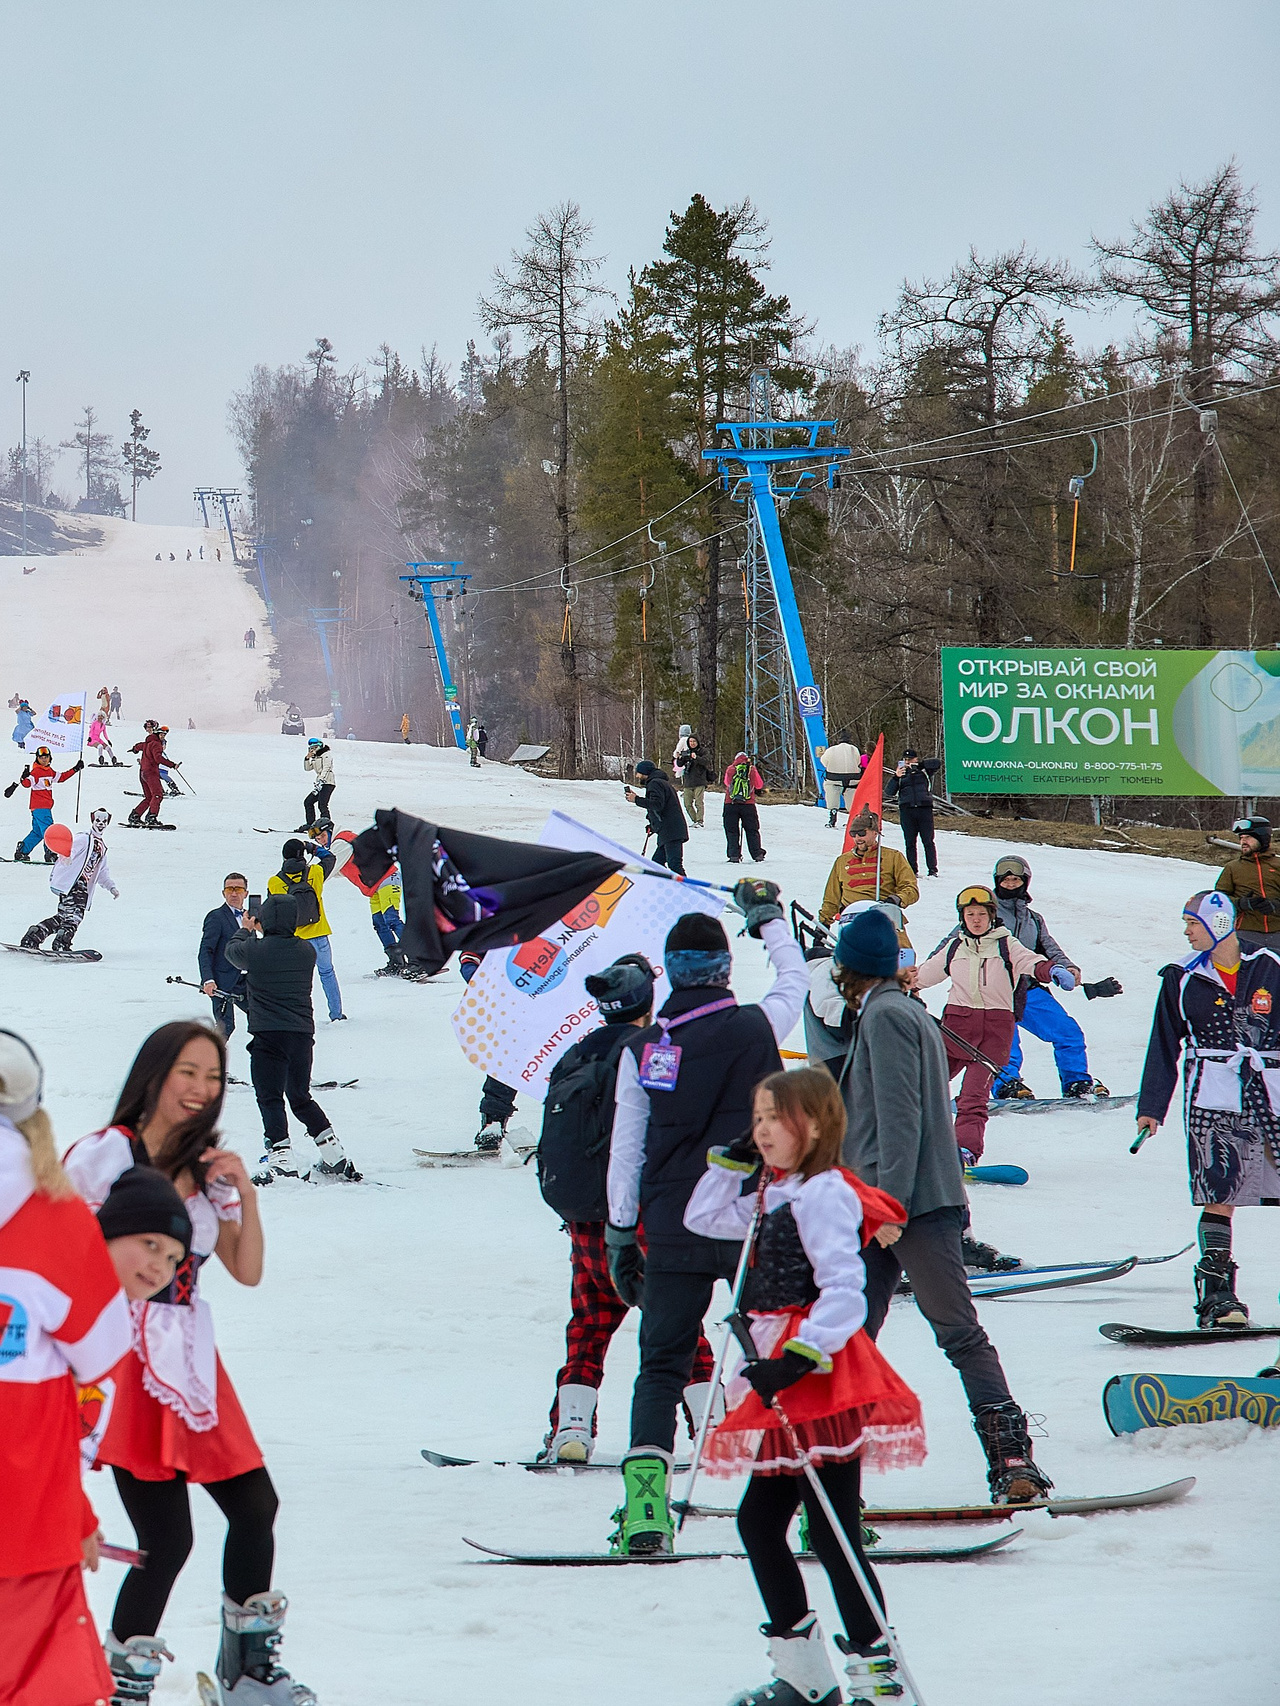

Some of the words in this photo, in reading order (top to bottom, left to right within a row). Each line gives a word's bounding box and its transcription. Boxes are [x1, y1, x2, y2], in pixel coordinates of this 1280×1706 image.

[957, 656, 1087, 677] ОТКРЫВАЙ
[1093, 658, 1158, 677] СВОЙ
[959, 682, 1009, 698] МИР
[1016, 683, 1046, 699] ЗА
[1055, 683, 1155, 700] ОКНАМИ
[961, 705, 1160, 746] ОЛКОН
[962, 760, 1078, 770] WWW.OKNA-OLKON.RU
[1084, 761, 1162, 771] 8-800-775-11-75
[963, 774, 1024, 783] ЧЕЛЯБИНСК
[1033, 775, 1111, 784] ЕКАТЕРИНБУРГ
[1120, 775, 1163, 784] ТЮМЕНЬ
[1210, 893, 1224, 908] 4
[599, 999, 622, 1010] ER
